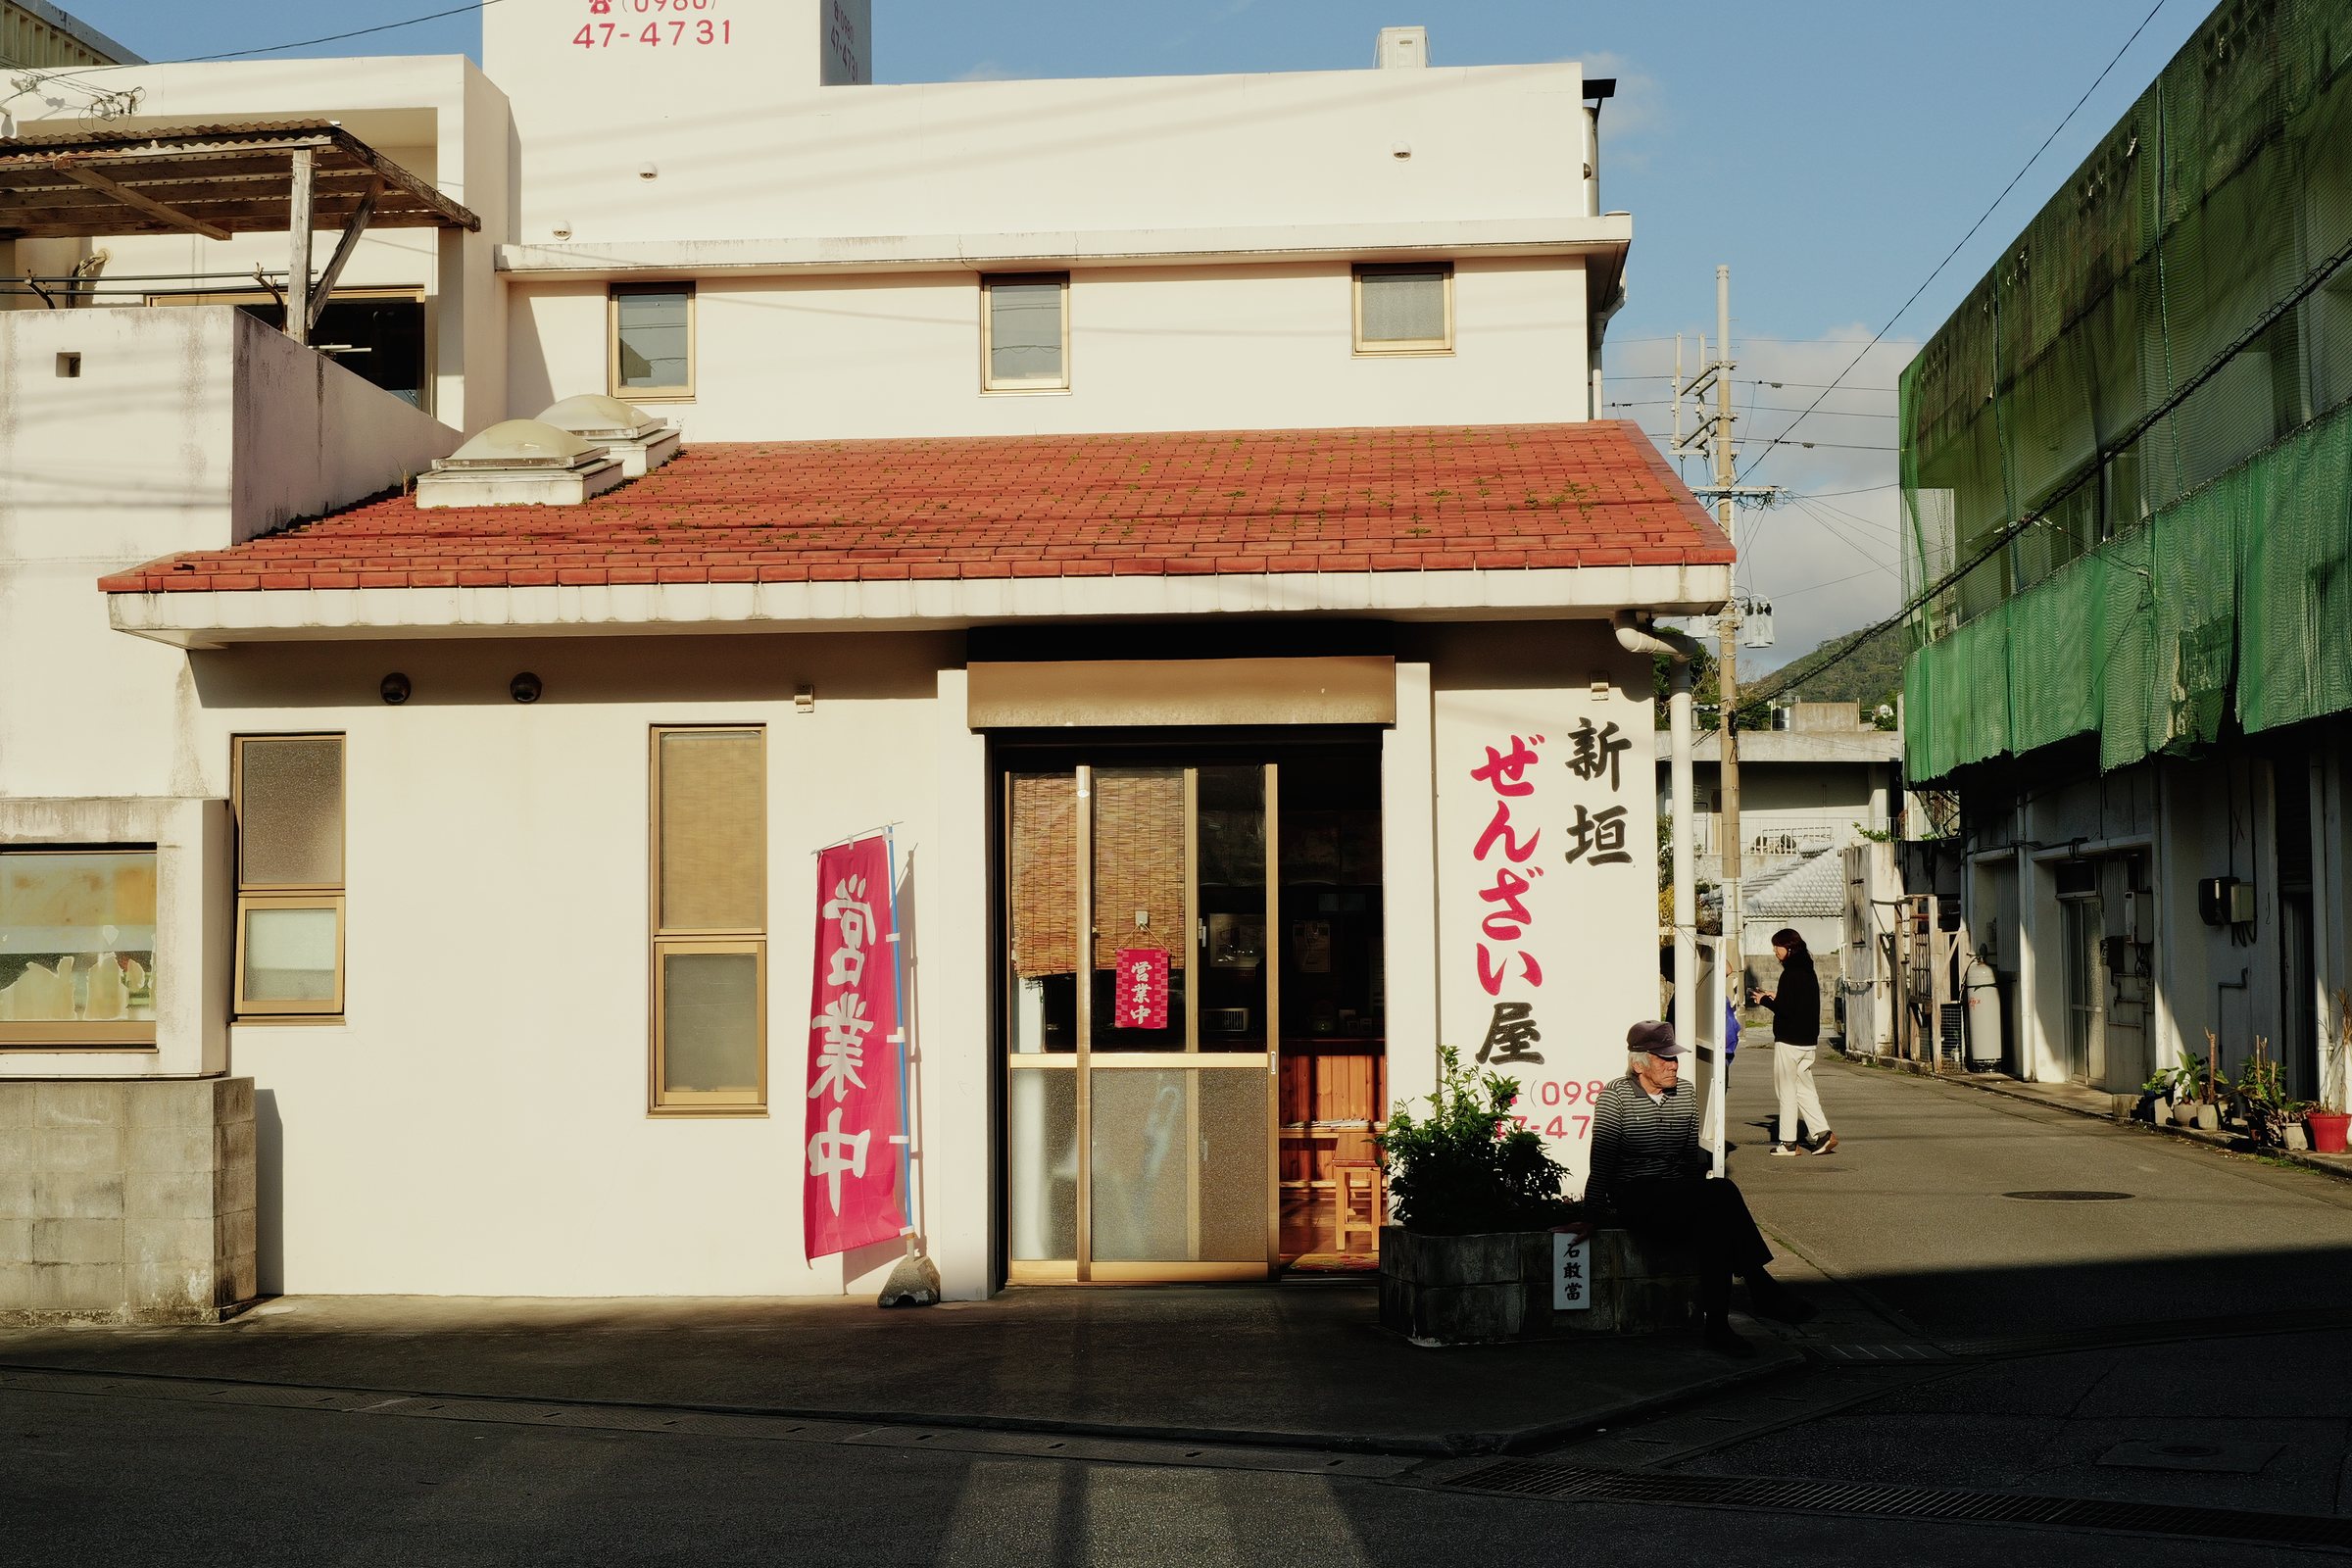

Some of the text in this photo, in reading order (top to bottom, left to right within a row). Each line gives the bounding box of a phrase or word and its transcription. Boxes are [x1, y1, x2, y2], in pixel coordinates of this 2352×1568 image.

[572, 20, 730, 49] 47-4731
[1565, 717, 1633, 866] 新垣
[1470, 734, 1545, 1065] ぜんざい屋
[1130, 961, 1152, 1025] 営業中
[808, 874, 877, 1217] 営業中
[1530, 1079, 1604, 1106] (098
[1495, 1115, 1592, 1140] 7-47
